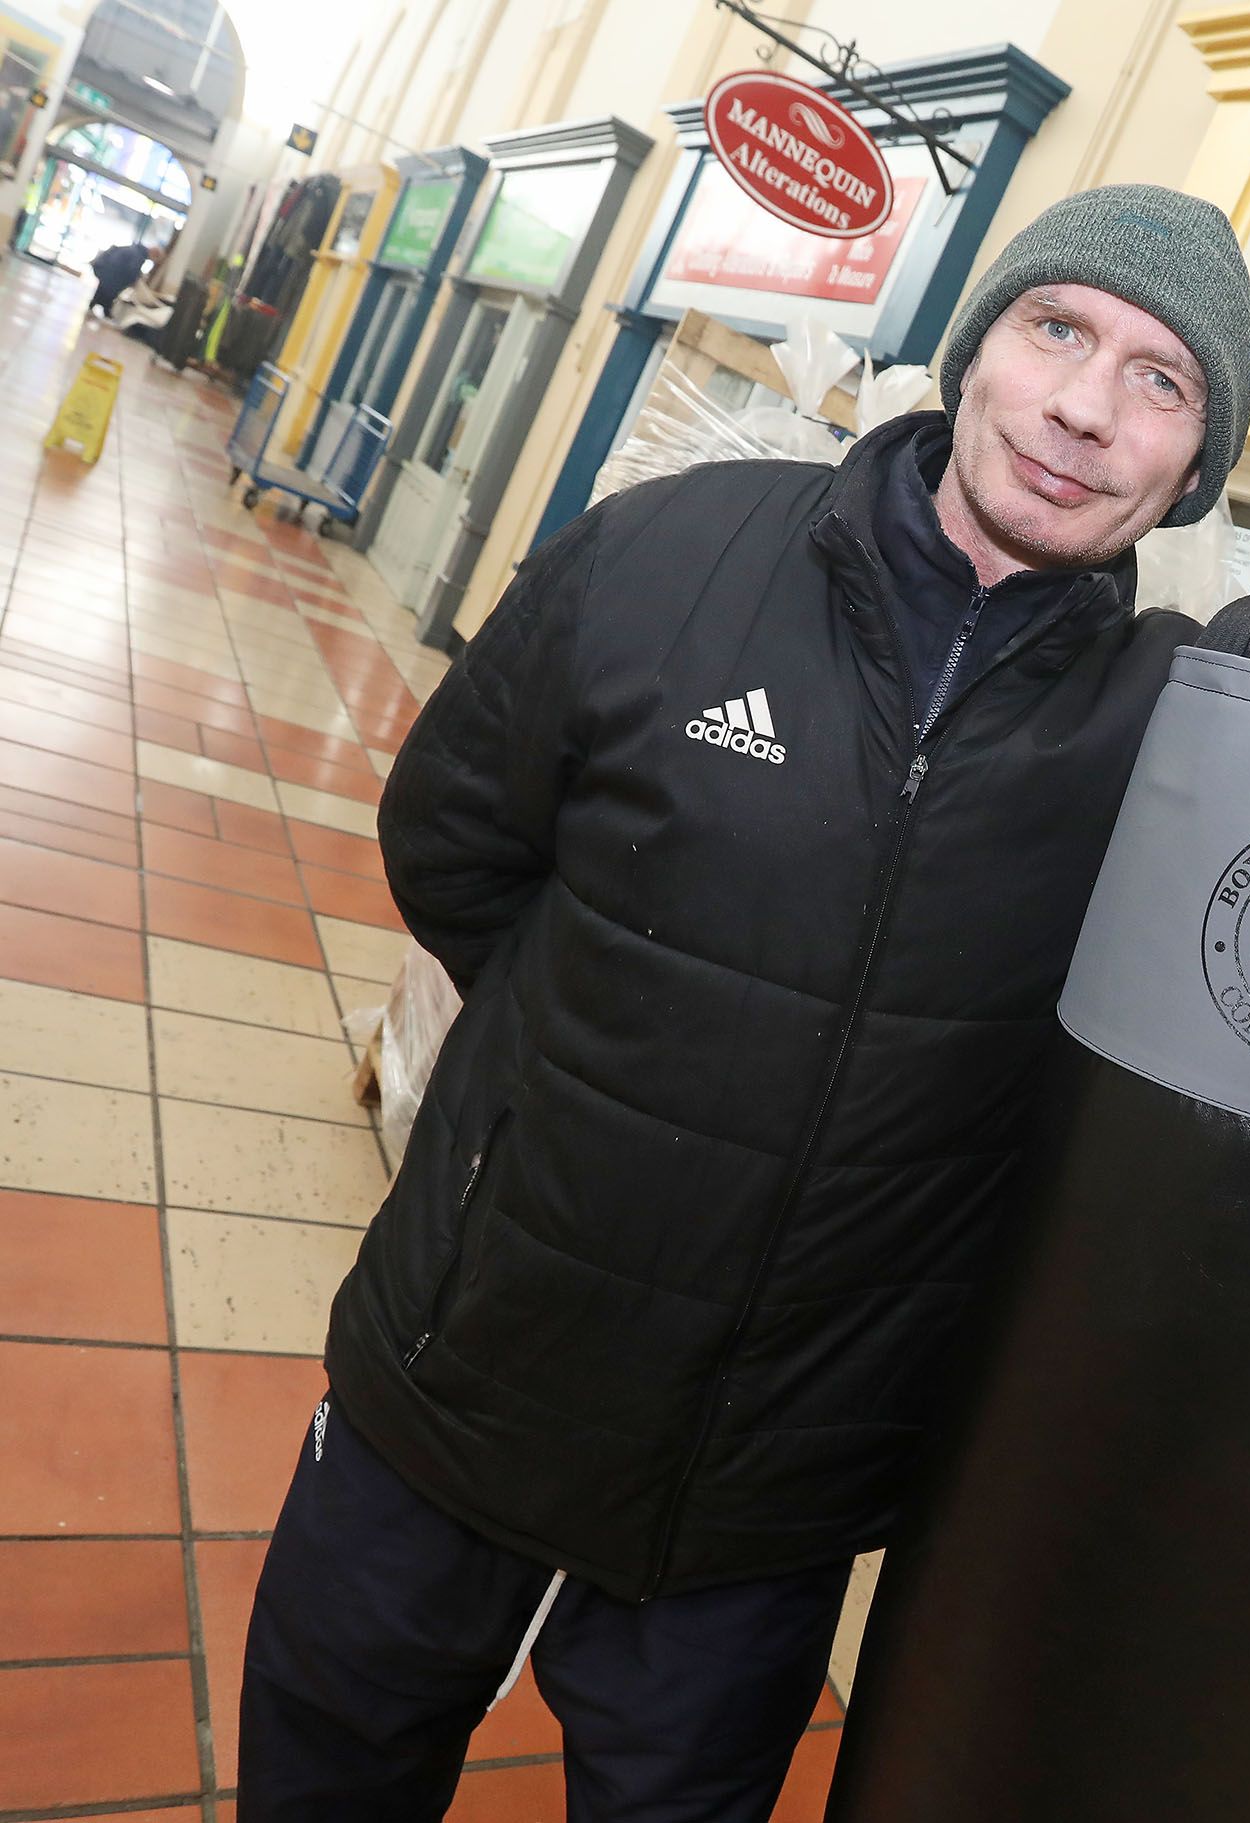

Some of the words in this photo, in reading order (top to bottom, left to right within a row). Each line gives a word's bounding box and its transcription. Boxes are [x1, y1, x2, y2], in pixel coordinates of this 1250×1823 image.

[727, 97, 877, 209] MANNEQUIN
[729, 142, 851, 230] Alterations
[685, 719, 786, 765] adidas
